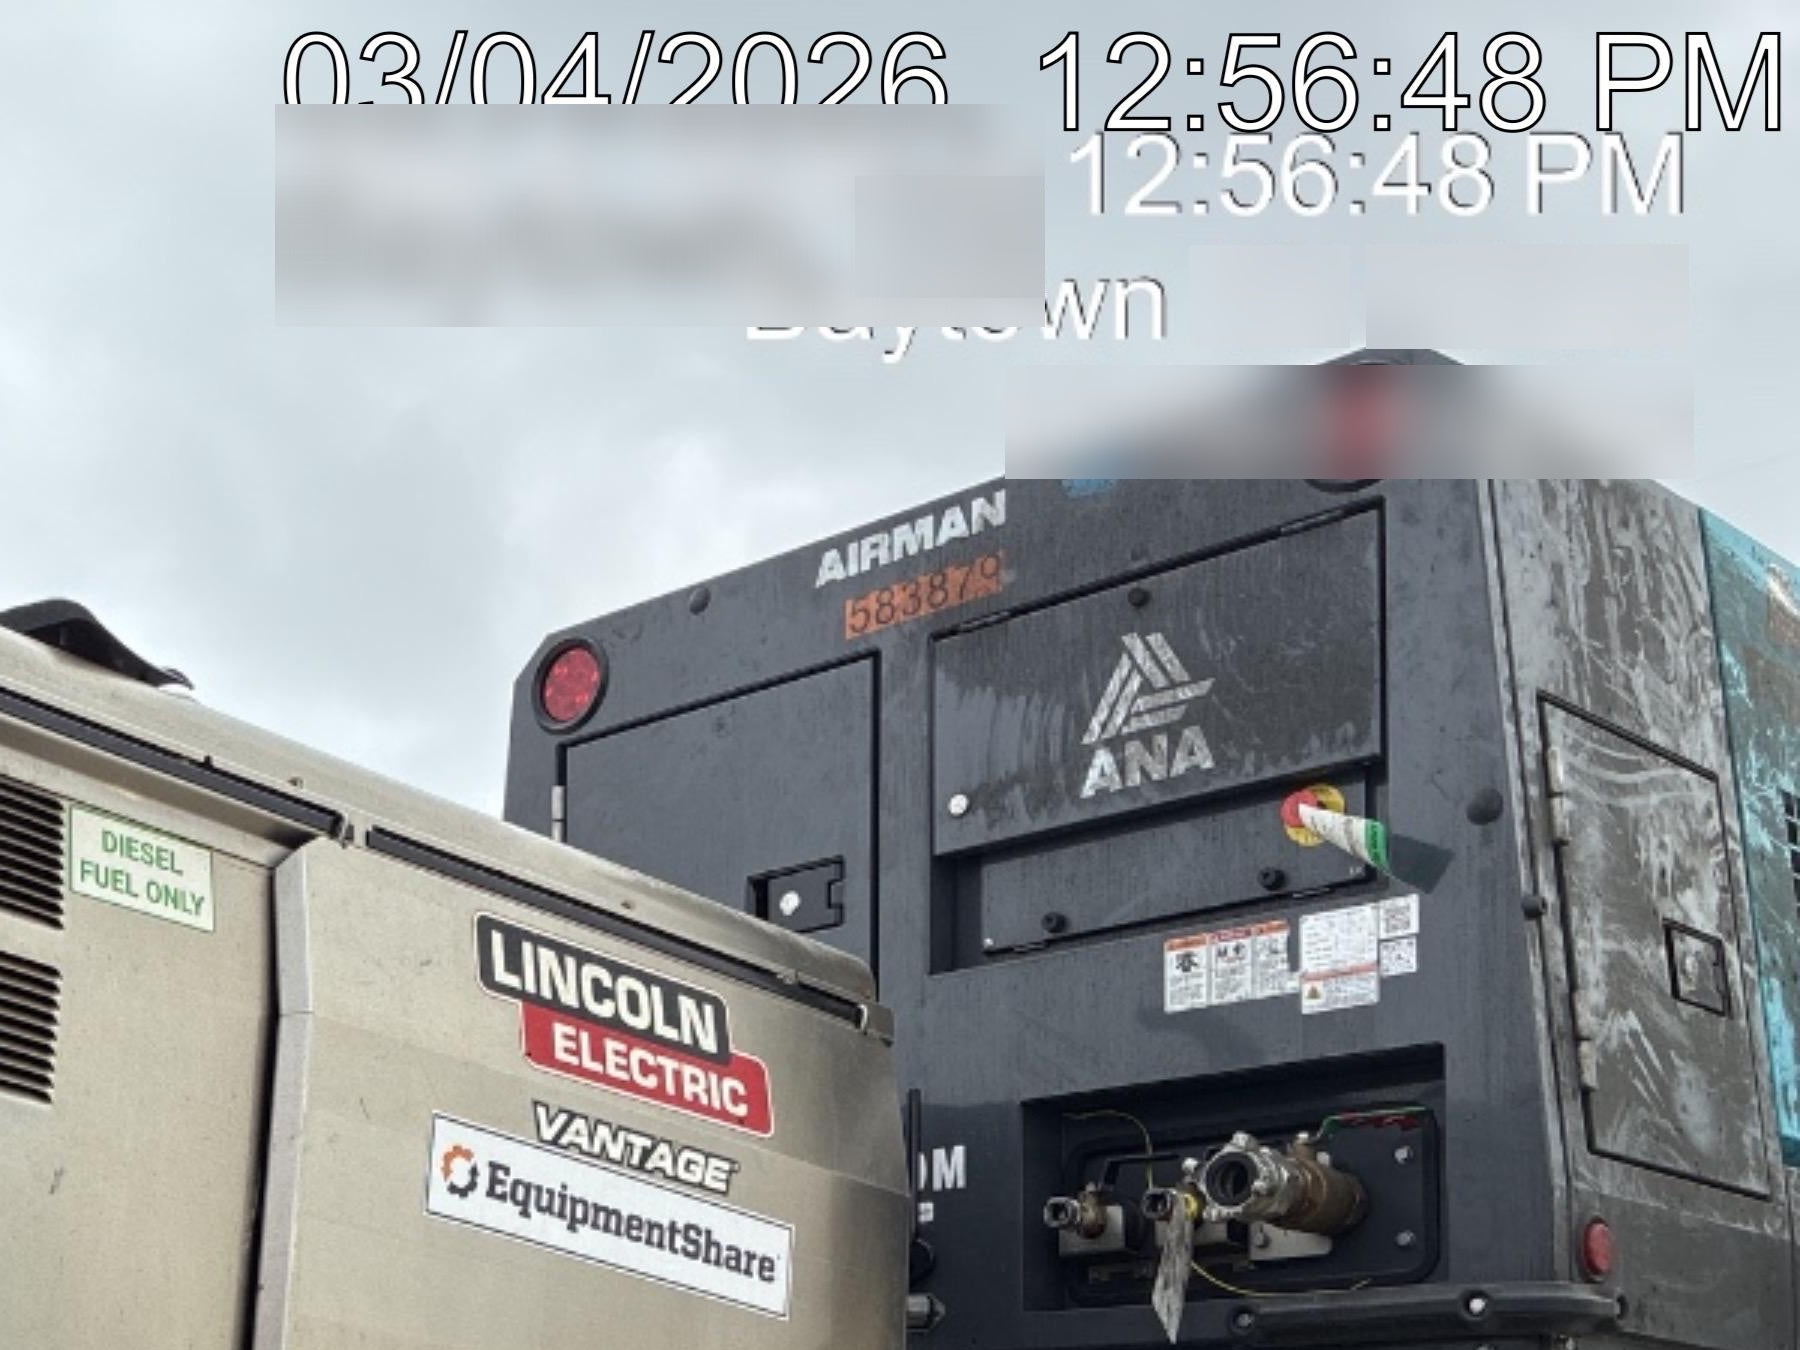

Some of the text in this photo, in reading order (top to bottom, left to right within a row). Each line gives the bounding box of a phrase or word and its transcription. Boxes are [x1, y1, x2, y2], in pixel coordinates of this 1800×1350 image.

[814, 488, 1006, 590] AIRMAN
[1080, 725, 1215, 798] ANA
[79, 857, 205, 916] FUEL ONLY
[101, 828, 183, 877] DIESEL
[490, 930, 719, 1055] LINCOLN
[551, 1020, 749, 1118] ELECTRIC
[531, 1099, 735, 1197] VANTAGE
[485, 1160, 776, 1284] EquipmentShare
